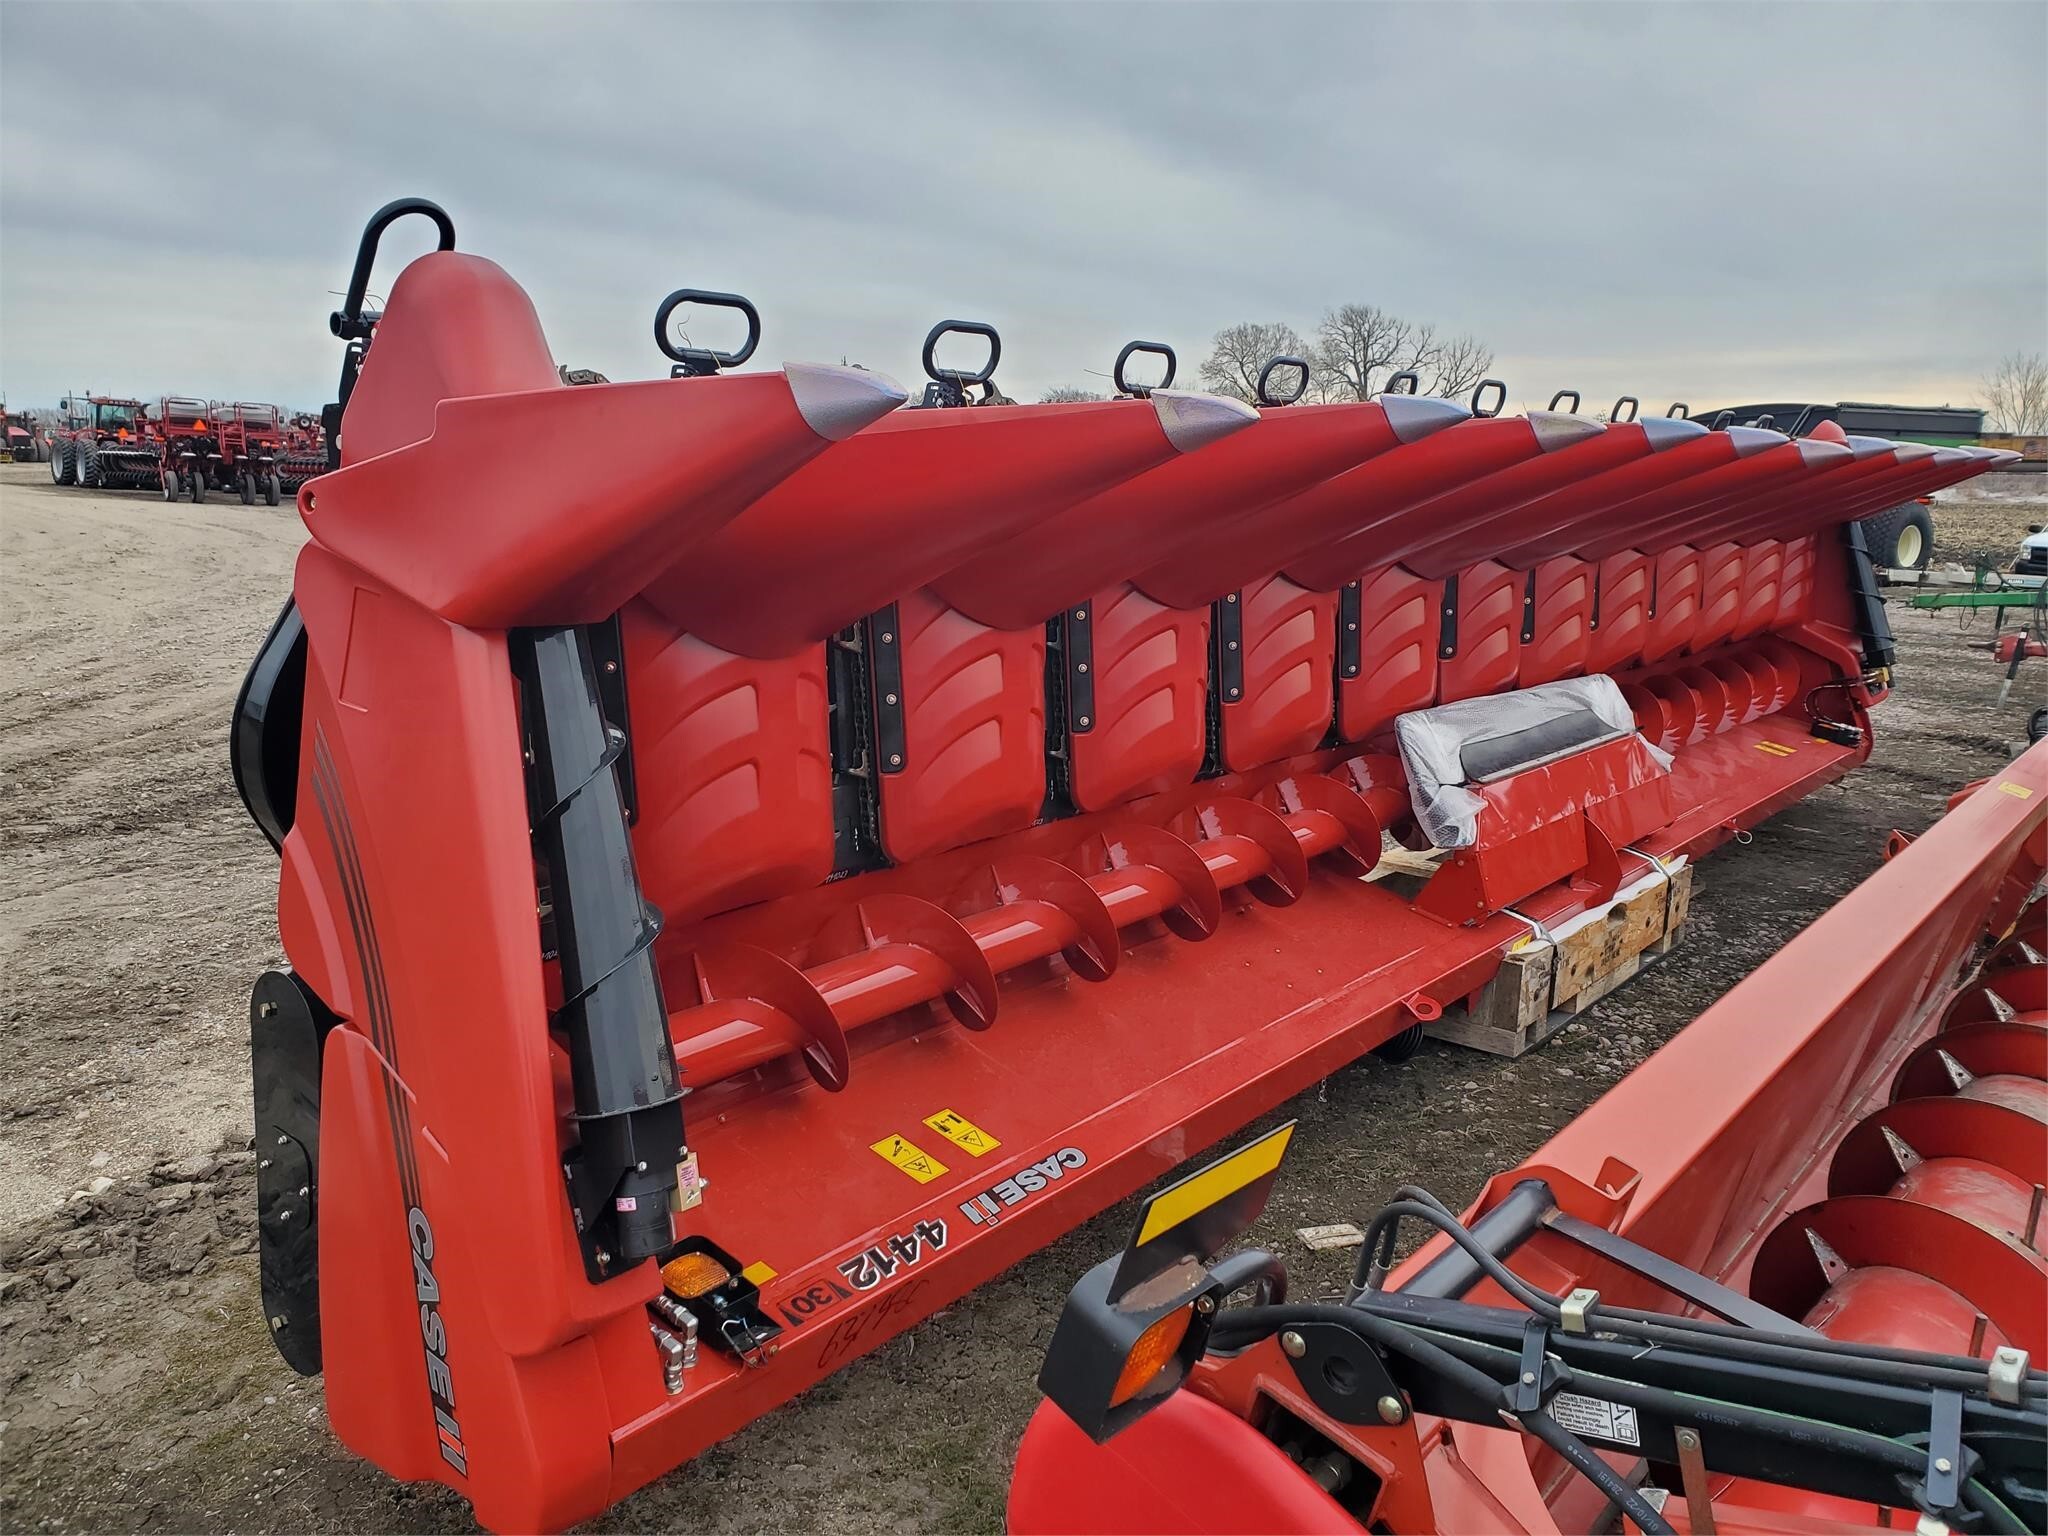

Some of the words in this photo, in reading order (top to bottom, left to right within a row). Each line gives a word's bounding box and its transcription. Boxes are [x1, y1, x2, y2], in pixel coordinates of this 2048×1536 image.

[992, 1147, 1088, 1207] CASE
[837, 1217, 949, 1291] 4412
[408, 1206, 456, 1408] CASE
[791, 1286, 833, 1314] 30
